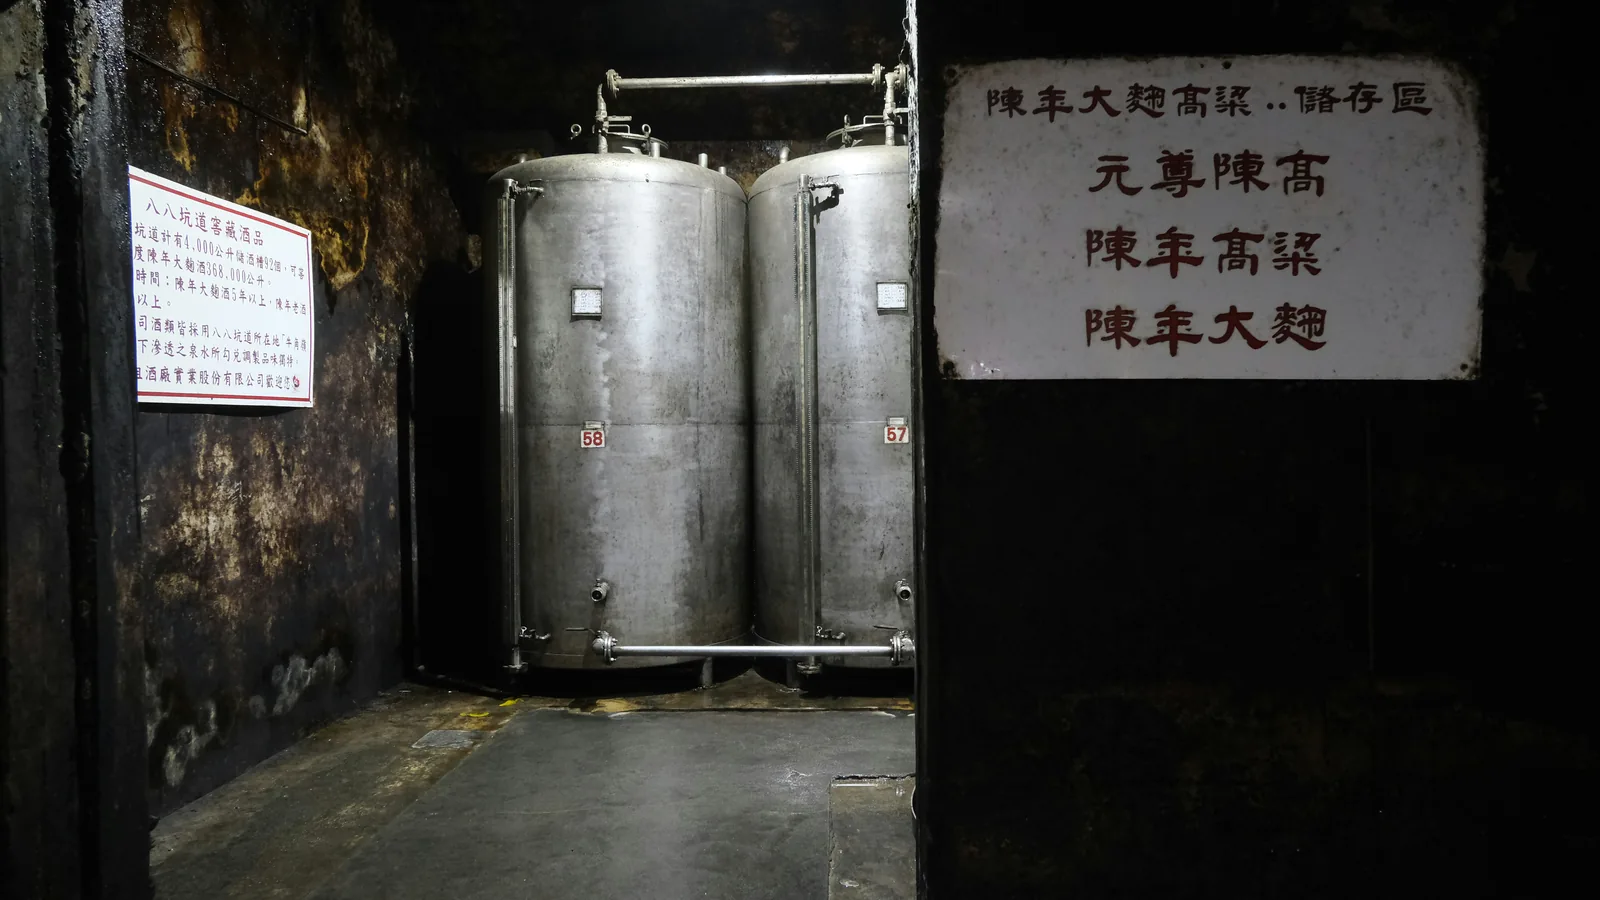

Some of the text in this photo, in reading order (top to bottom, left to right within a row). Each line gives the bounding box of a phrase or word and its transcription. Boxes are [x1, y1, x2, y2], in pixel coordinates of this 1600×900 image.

[146, 197, 264, 246] 八八坑道窖藏酒品
[583, 431, 603, 446] 58
[887, 427, 907, 441] 57
